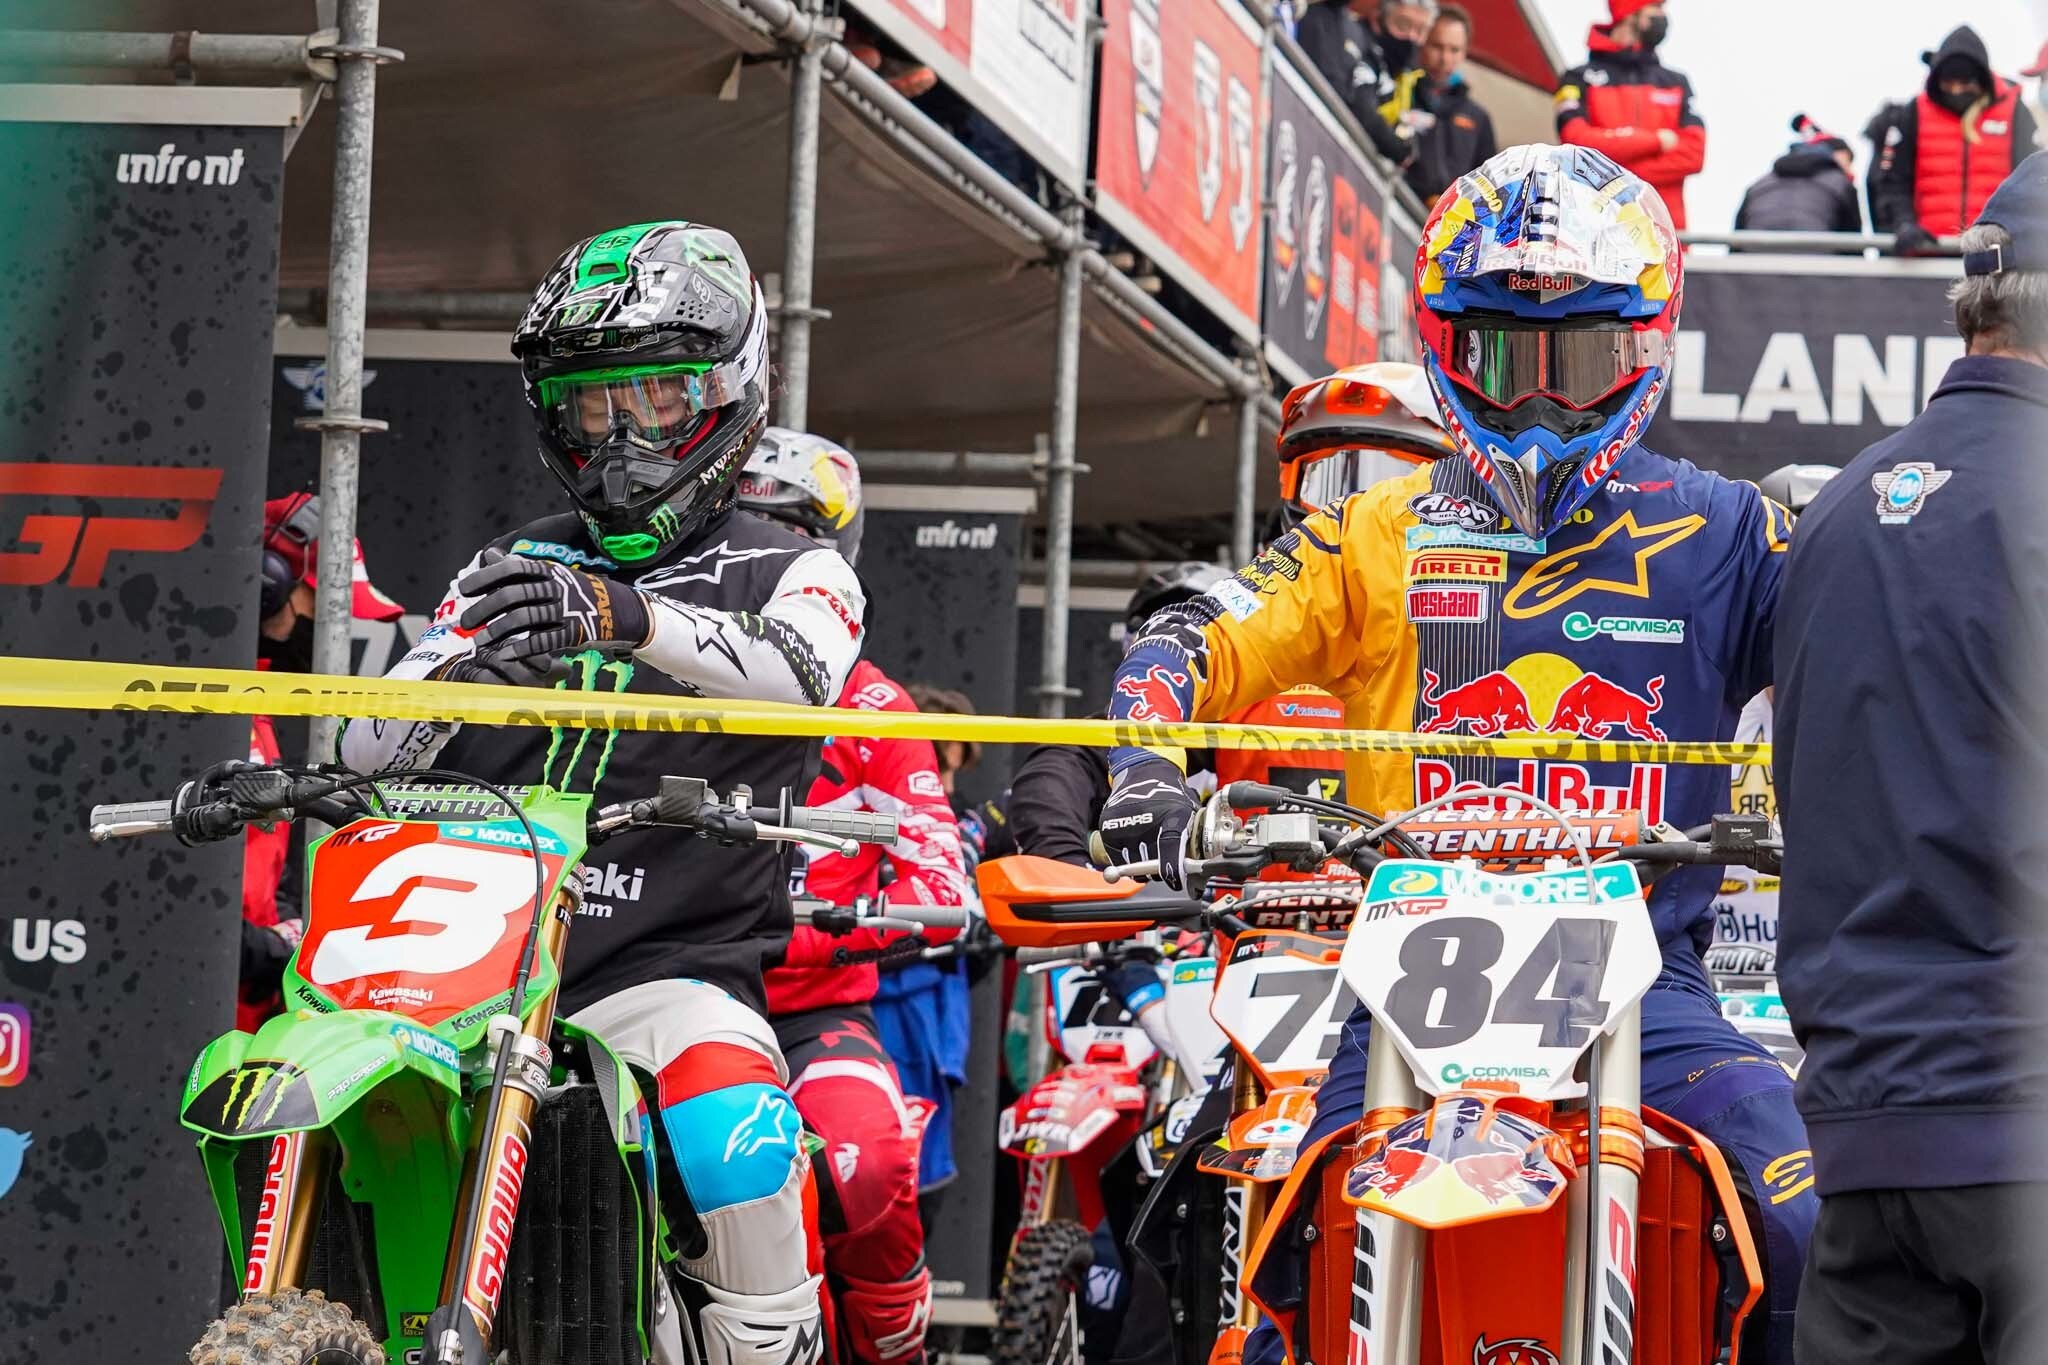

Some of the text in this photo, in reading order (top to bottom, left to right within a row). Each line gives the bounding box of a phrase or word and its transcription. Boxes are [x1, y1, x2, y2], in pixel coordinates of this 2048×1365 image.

[1509, 273, 1573, 291] Red Bull
[740, 480, 775, 496] Bull
[1438, 528, 1540, 551] MOTOREX
[1410, 553, 1501, 577] PIRELLI
[1601, 617, 1681, 636] COMISA
[1414, 758, 1668, 827] Red Bull
[1404, 824, 1623, 853] RENTHAL
[1442, 869, 1610, 903] MOTOREX
[311, 843, 549, 985] 3
[1366, 898, 1447, 922] MXGP
[12, 918, 87, 962] US
[1386, 916, 1617, 1048] 84
[368, 988, 433, 1003] Kawasaki
[1473, 1066, 1550, 1079] COMISA
